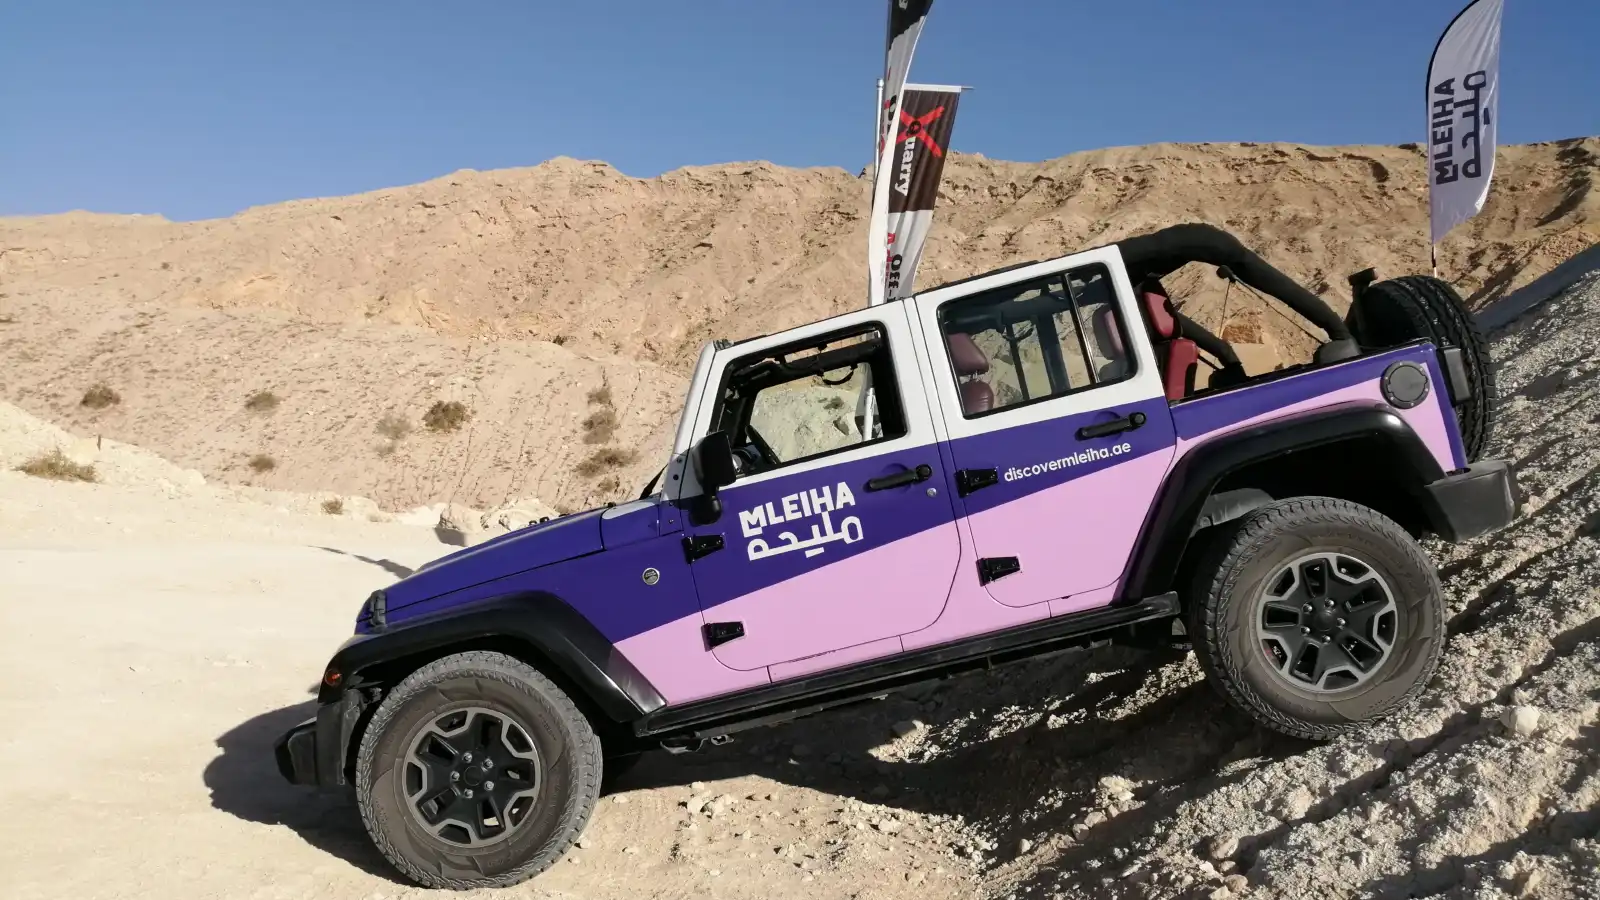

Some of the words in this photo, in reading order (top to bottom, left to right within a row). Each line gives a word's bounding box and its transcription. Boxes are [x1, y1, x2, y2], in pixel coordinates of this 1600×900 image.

[1433, 77, 1460, 186] MLEIHA
[1003, 442, 1132, 482] discovermleiha.ae
[738, 481, 856, 538] MLEIHA
